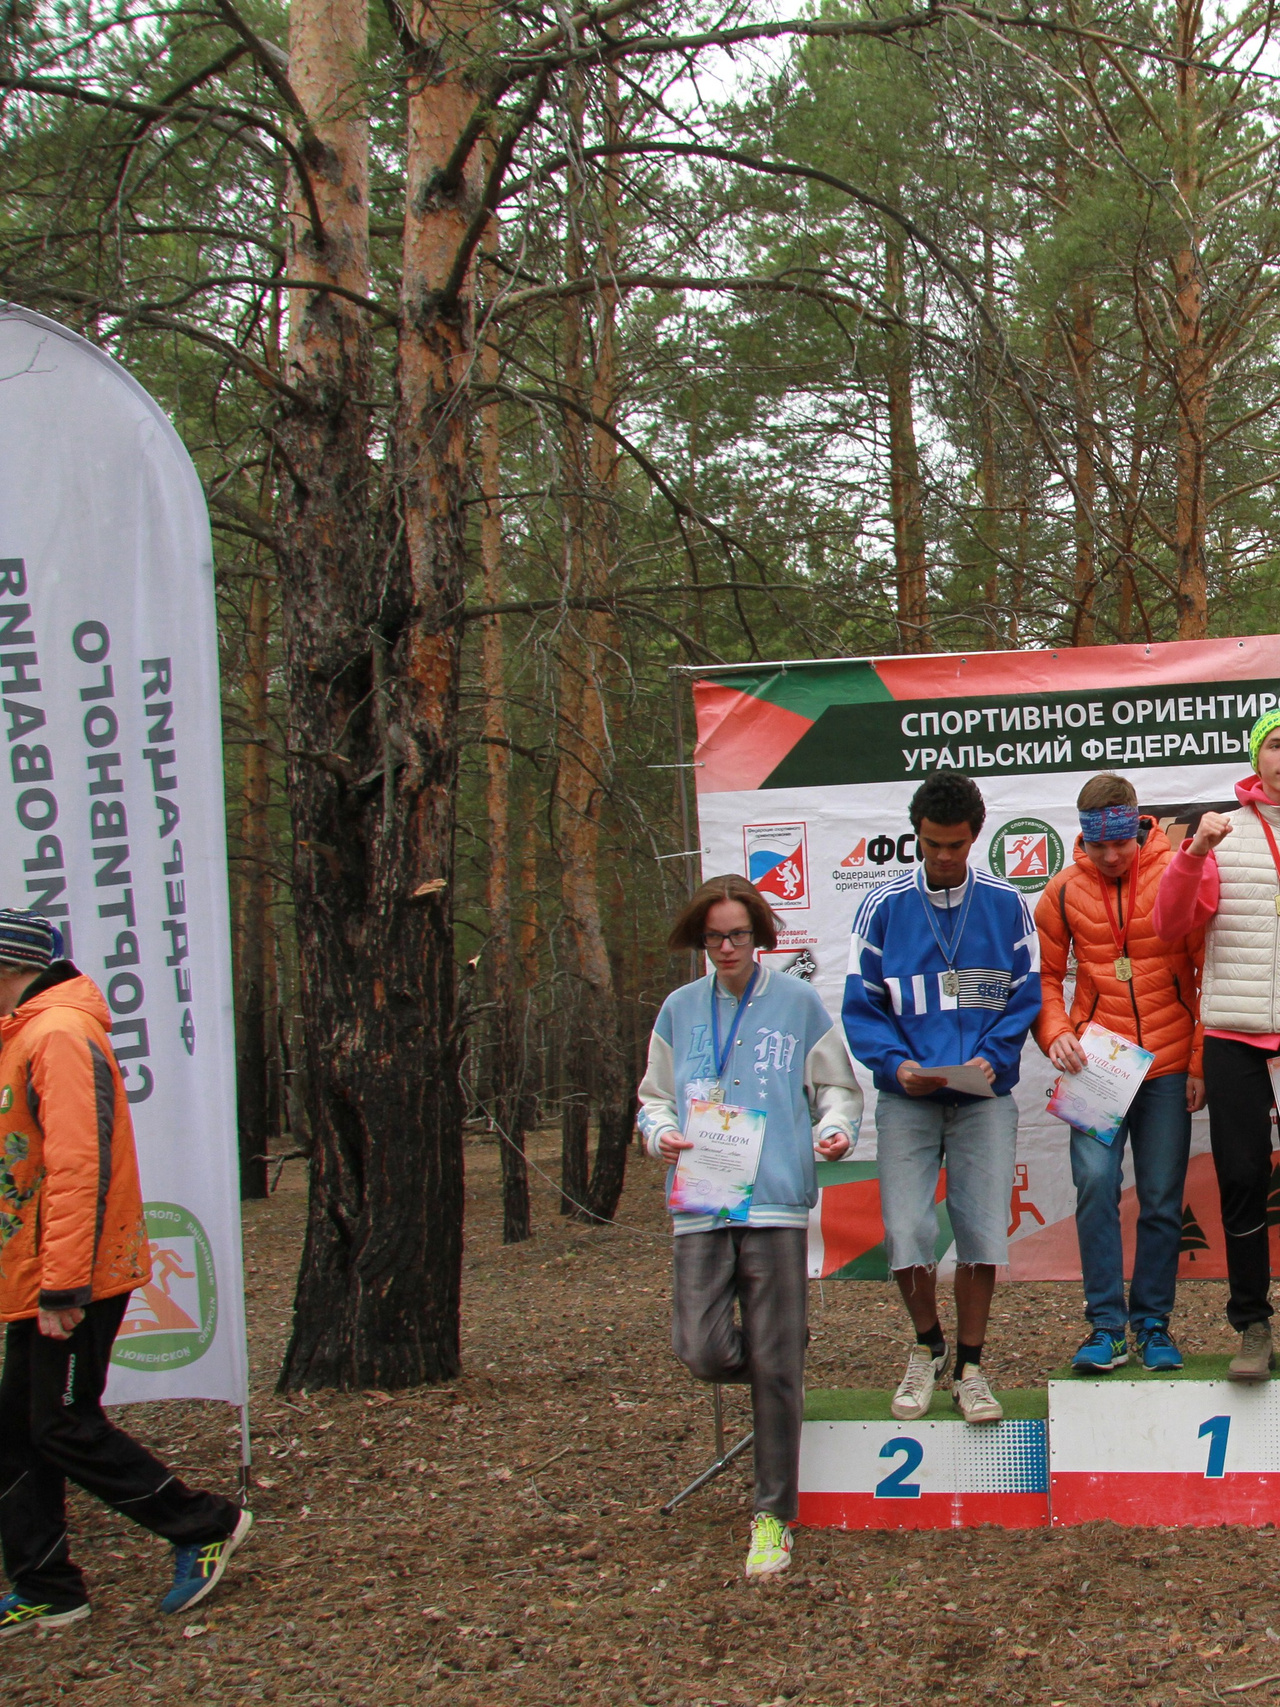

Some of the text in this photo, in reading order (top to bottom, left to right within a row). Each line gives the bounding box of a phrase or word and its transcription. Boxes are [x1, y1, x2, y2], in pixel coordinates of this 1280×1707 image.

[901, 701, 1104, 738] СПОРТИВНОЕ
[902, 735, 1072, 772] УРАЛЬСКИЙ
[1081, 729, 1251, 763] ФЕДЕРАЛЬ
[1010, 821, 1049, 832] СПОРТИВНОГО
[832, 870, 886, 883] Федерация
[699, 1131, 750, 1146] ДИПЛОМ
[1197, 1415, 1231, 1478] 1
[874, 1436, 924, 1498] 2
